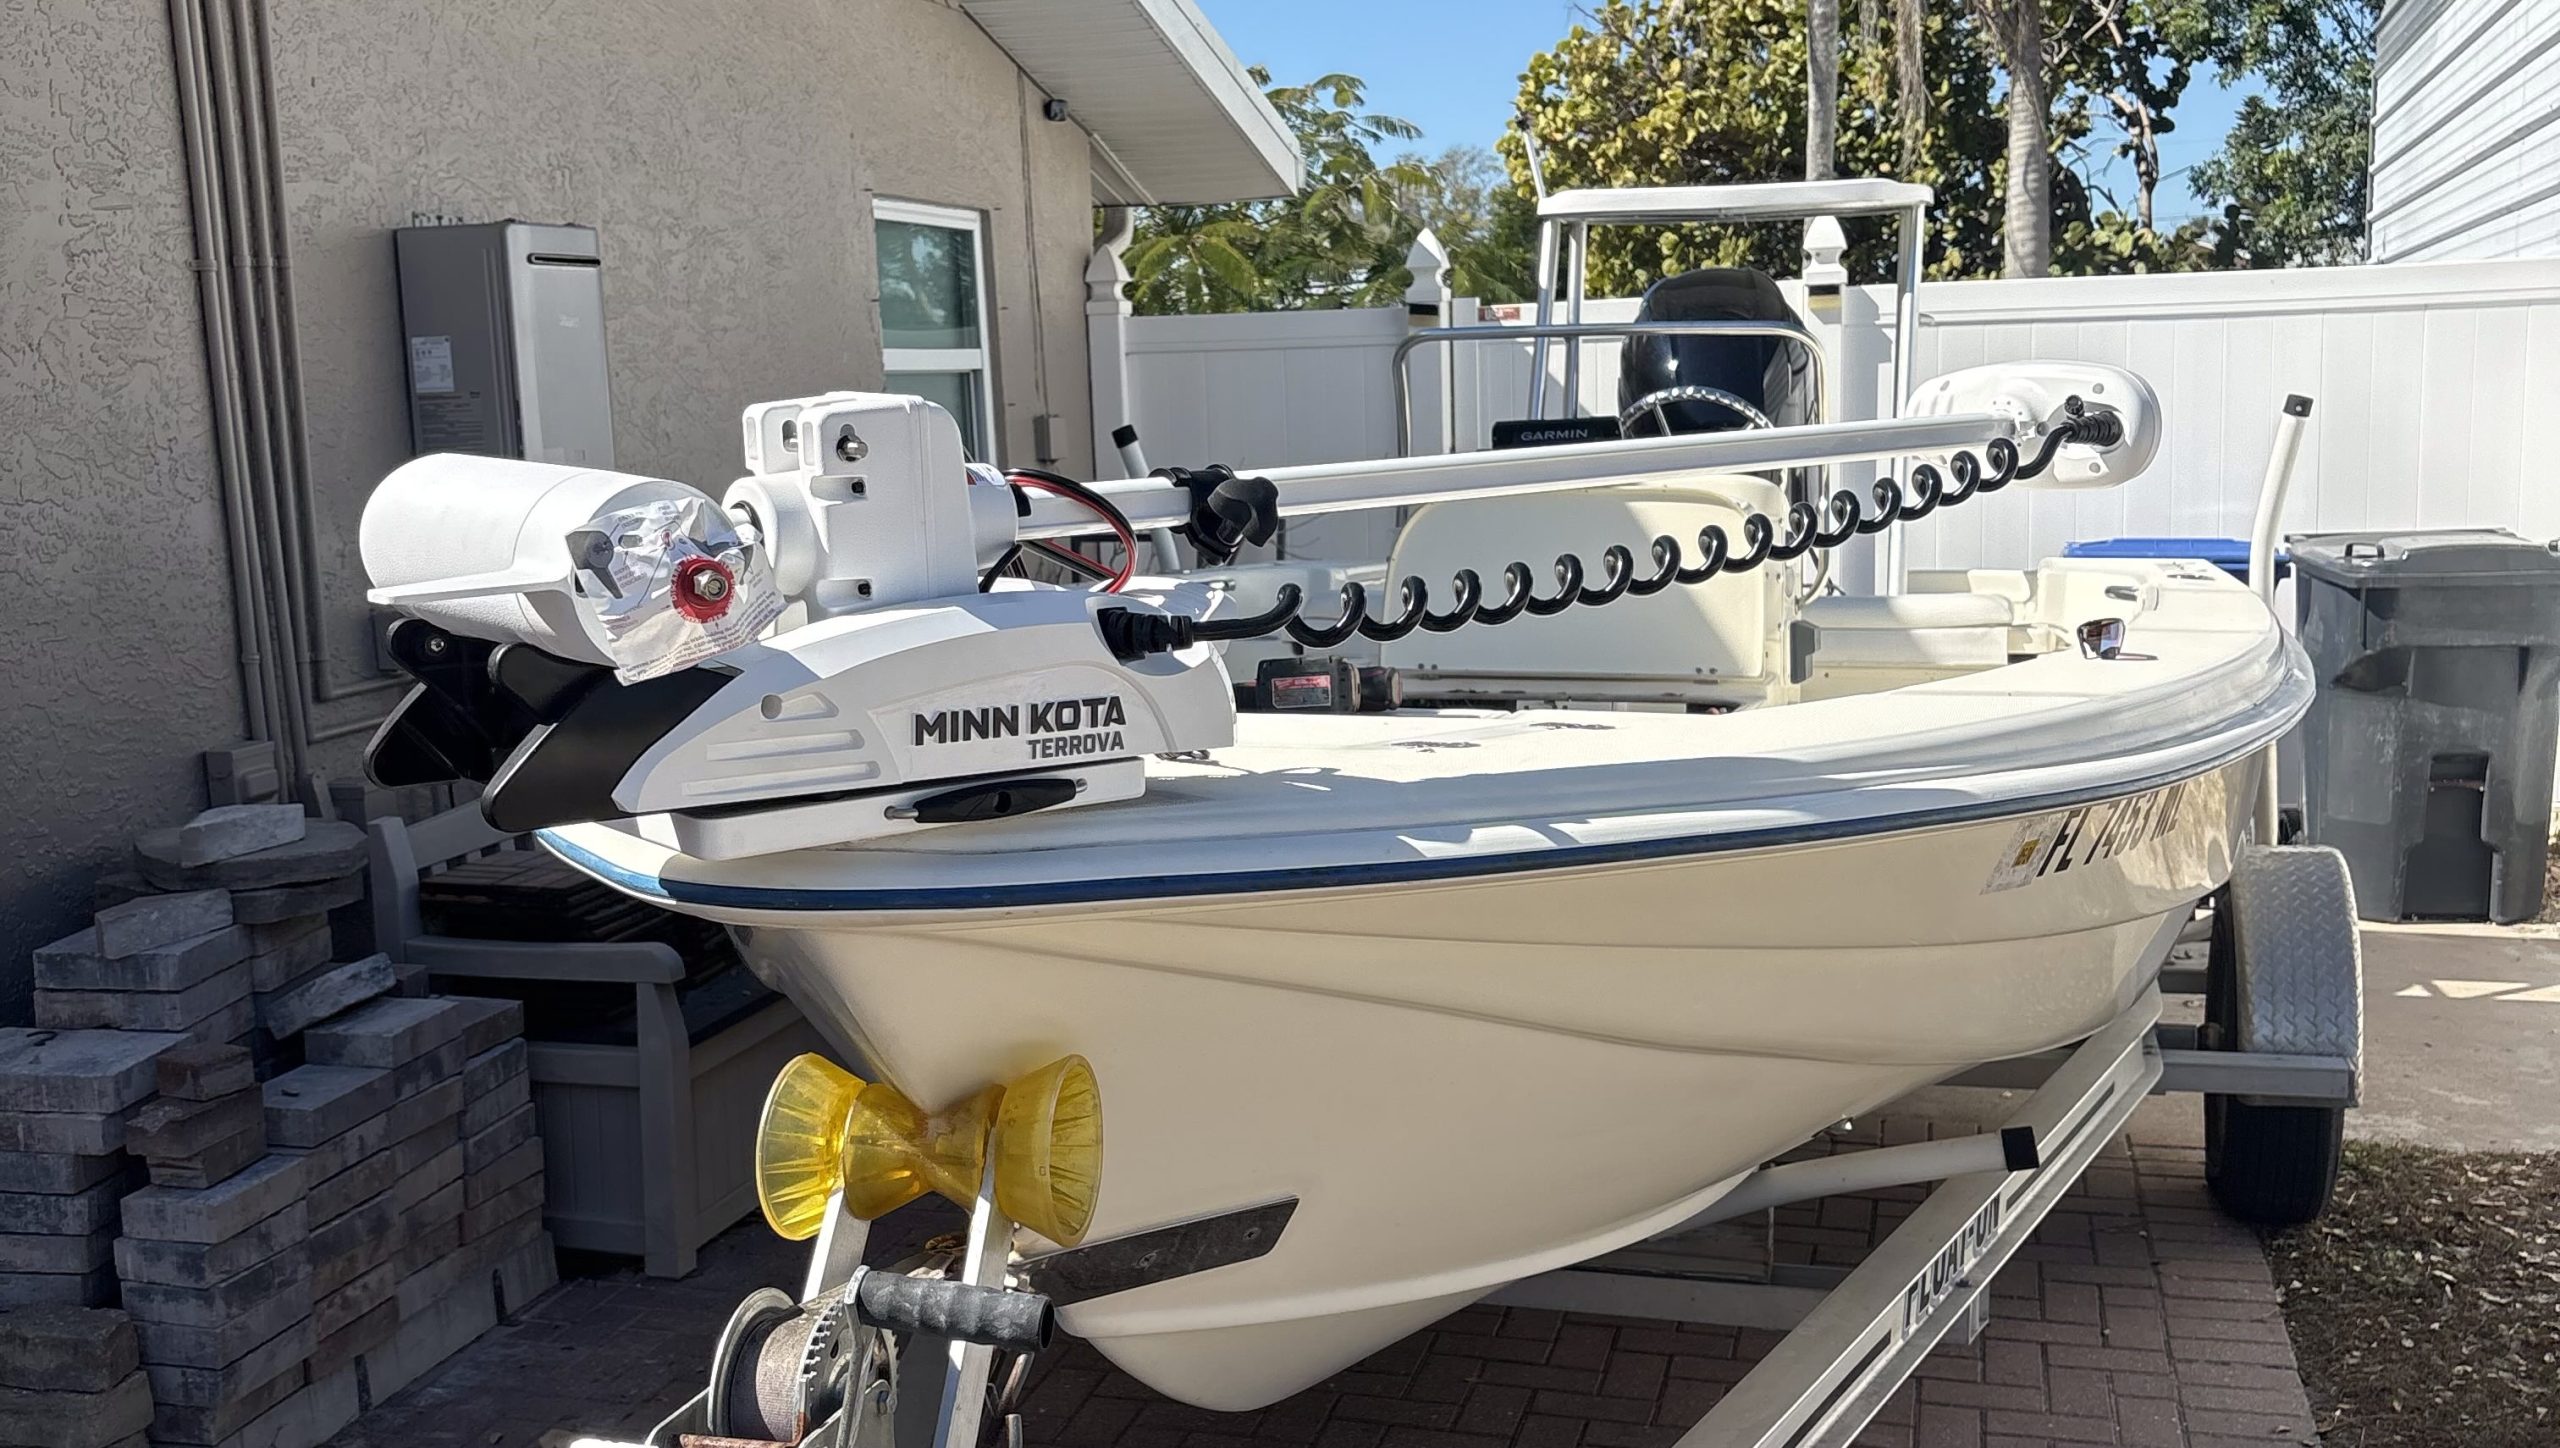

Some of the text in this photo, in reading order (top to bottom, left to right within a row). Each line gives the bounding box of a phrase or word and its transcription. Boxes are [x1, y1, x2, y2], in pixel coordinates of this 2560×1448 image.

[1520, 428, 1588, 441] GARMIN
[914, 696, 1127, 746] MINN KOTA
[1028, 731, 1125, 760] TERROVA
[2036, 807, 2091, 878] FL
